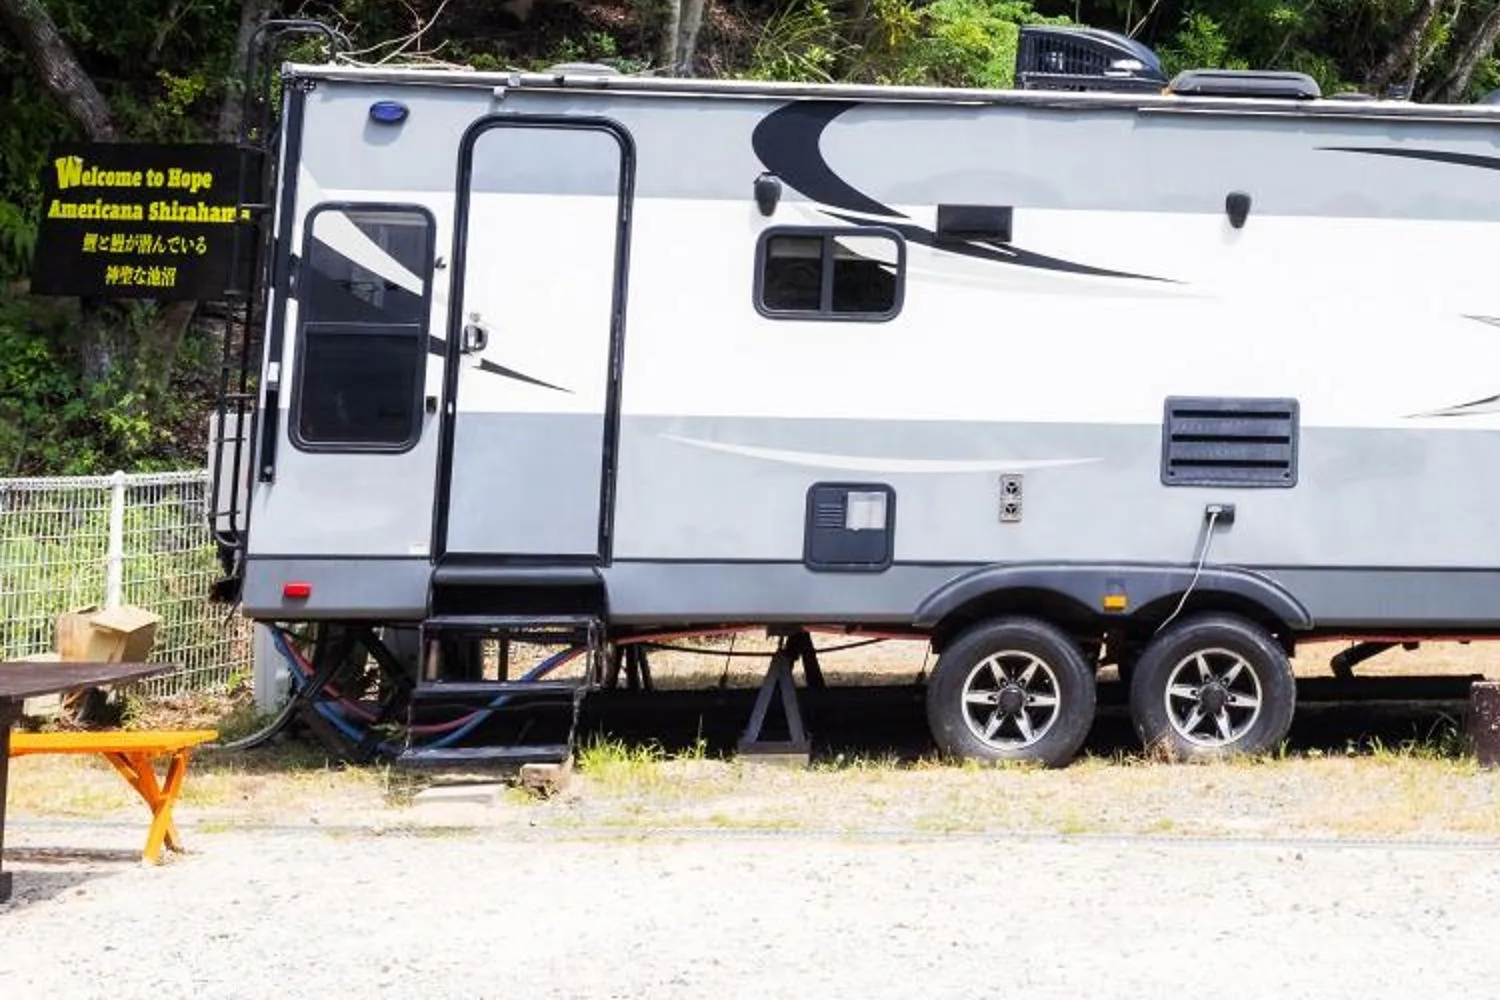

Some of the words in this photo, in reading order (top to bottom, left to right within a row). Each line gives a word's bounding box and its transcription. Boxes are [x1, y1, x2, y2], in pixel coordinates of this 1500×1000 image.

[55, 155, 142, 189] Welcome
[146, 168, 165, 187] to
[167, 167, 213, 193] Hope
[47, 198, 143, 220] Americana
